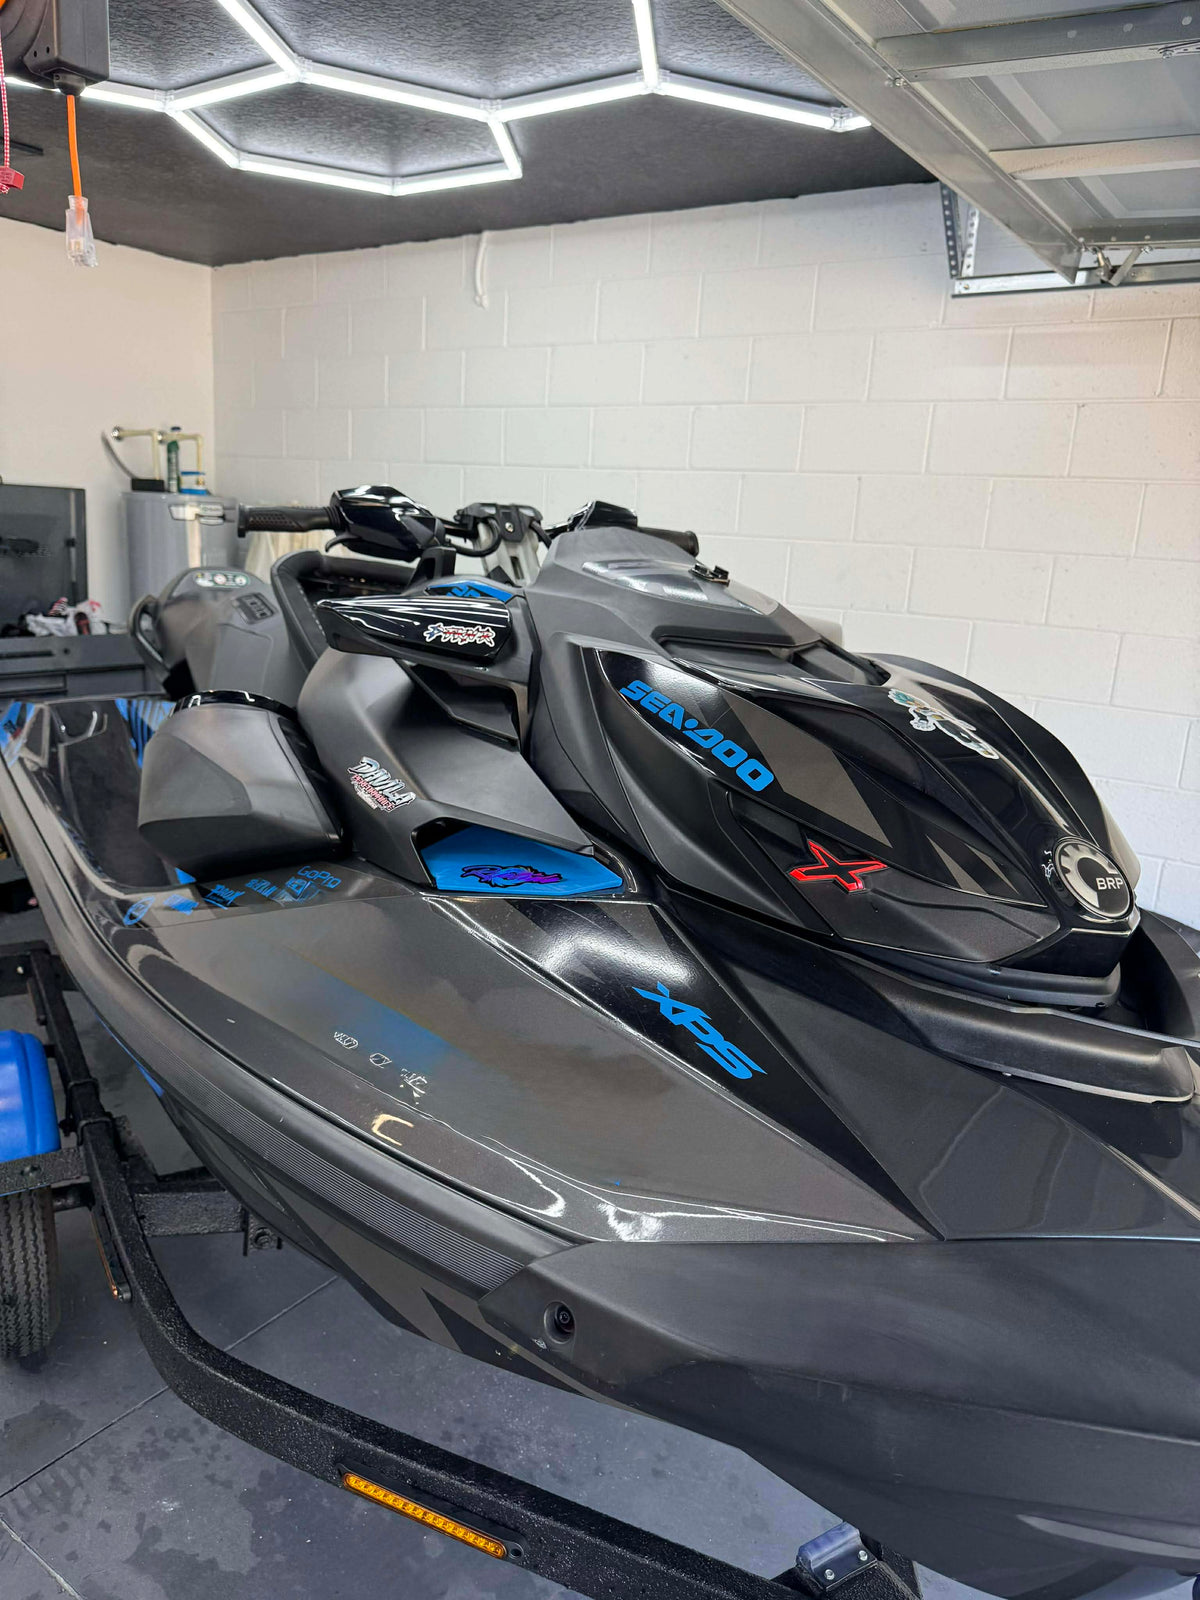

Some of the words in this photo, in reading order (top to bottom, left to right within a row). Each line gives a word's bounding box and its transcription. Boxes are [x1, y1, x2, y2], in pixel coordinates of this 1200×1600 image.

[297, 866, 342, 889] GoPro
[1096, 877, 1124, 890] BRP
[632, 981, 768, 1079] XPS
